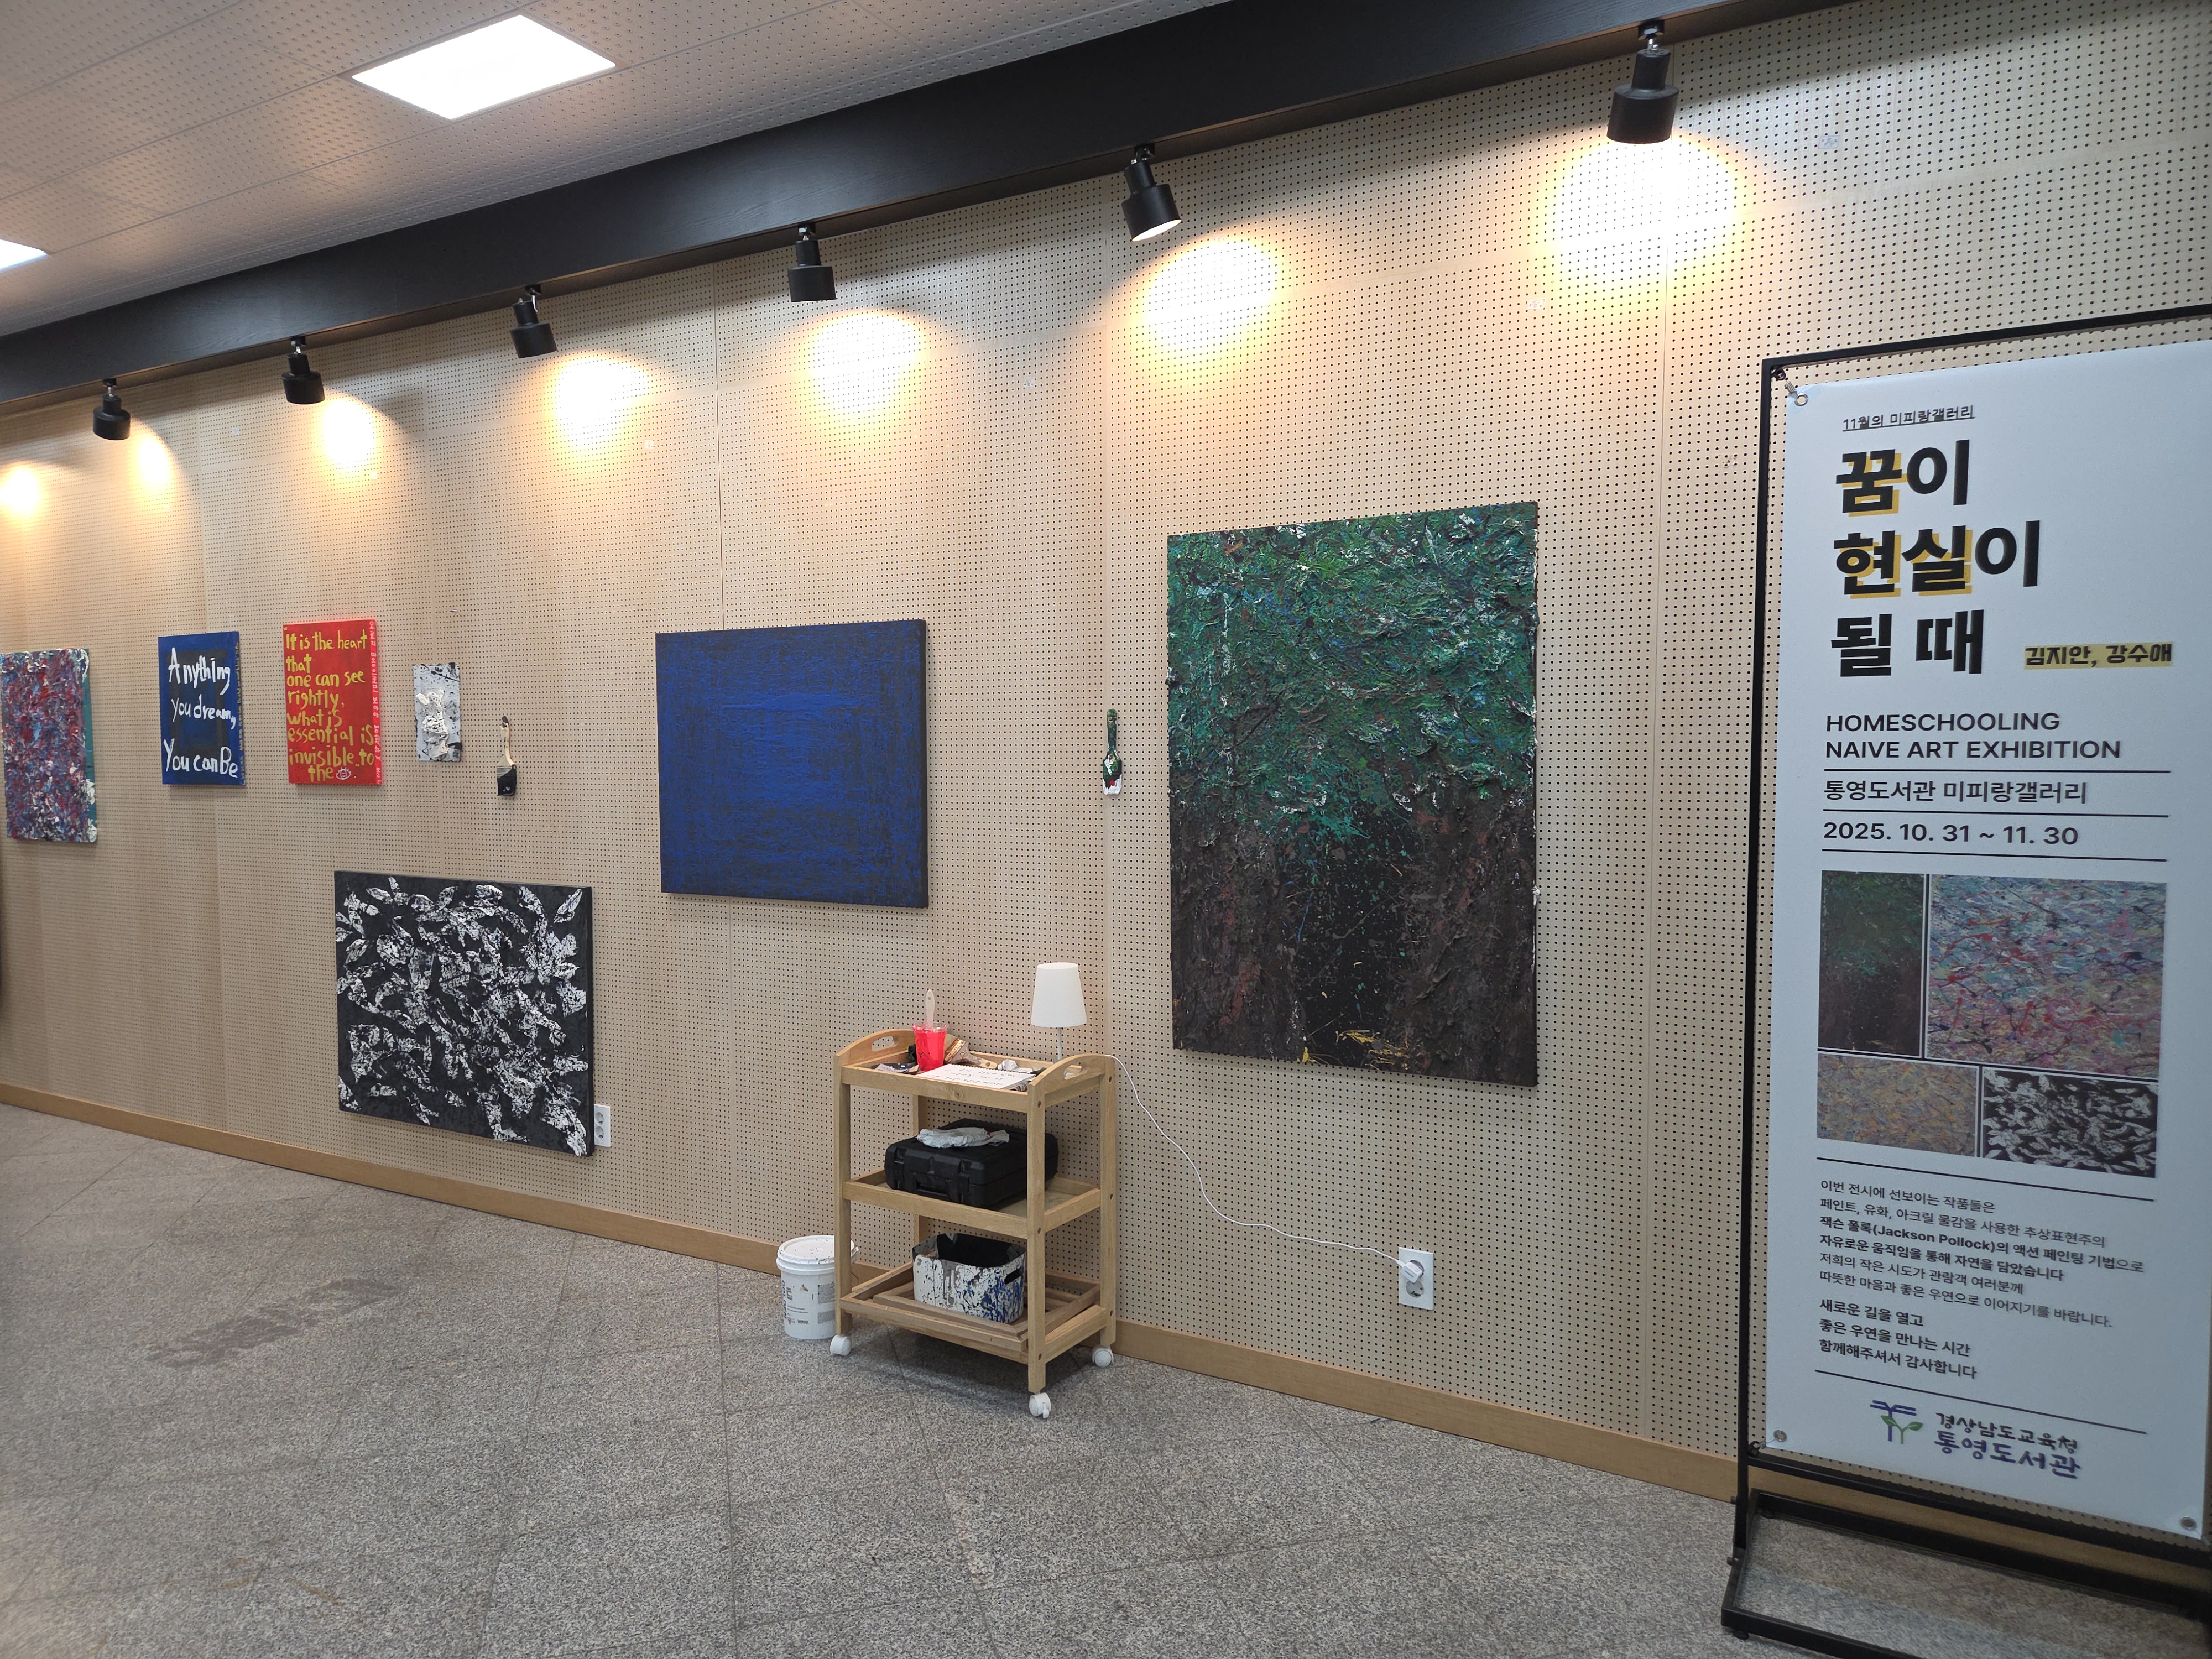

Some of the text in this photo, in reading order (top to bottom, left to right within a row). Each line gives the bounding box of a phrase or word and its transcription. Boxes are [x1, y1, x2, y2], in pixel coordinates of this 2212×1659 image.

[1843, 405, 1974, 431] 11월의 미피랑갤러리
[1835, 440, 1970, 514] 꿈이
[1833, 520, 2041, 597] 현실이
[300, 634, 310, 650] is
[312, 631, 335, 651] the
[337, 628, 367, 649] heart
[1831, 609, 1984, 677] 될 때
[2025, 644, 2172, 667] 김지안, 강수애
[168, 647, 231, 696] Anything
[286, 653, 312, 673] that
[286, 671, 366, 687] one can see
[193, 693, 236, 730] dream,
[288, 688, 345, 710] rightly,
[286, 709, 324, 726] what
[1826, 712, 2060, 732] HOMESCHOOLING
[288, 726, 353, 746] essential
[1825, 740, 2121, 759] NAIVE ART EXHIBITION
[163, 738, 238, 778] You can Be
[289, 745, 374, 768] invisible to
[307, 765, 334, 782] the
[1824, 780, 2087, 805] 통영도서관 미피랑갤러리
[1823, 822, 1892, 841] 2025.
[1899, 823, 1934, 842] 10.
[1942, 825, 1970, 843] 31
[2003, 826, 2036, 844] 11.
[2043, 826, 2079, 845] 30
[1821, 1180, 1995, 1214] 이번 전시에 선보이는 작품들은
[1820, 1198, 2105, 1248] 페인트, 유화, 아크릴 물감을 사용한 추상표현주의
[1820, 1216, 2145, 1272] 잭슨 폴록(Jackson Pollock)의 액션 페인팅 기법으로
[1820, 1234, 2064, 1282] 자유로운 움직임을 통해 자연을 담았습니다
[1820, 1253, 2024, 1295] 저희의 작은 시도가 관람객 여러분께
[1819, 1271, 2112, 1328] 따뜻한 마음과 좋은 우연으로 이어지기를 바랍니다.
[1819, 1298, 1924, 1327] 새로운 길을 열고
[1819, 1318, 1971, 1357] 좋은 우연을 만나는 시간
[1819, 1339, 1978, 1380] 함께해주셔서 감사합니다
[1936, 1412, 2078, 1455] 경상남도교육청
[1934, 1430, 2081, 1480] 통영도서관
